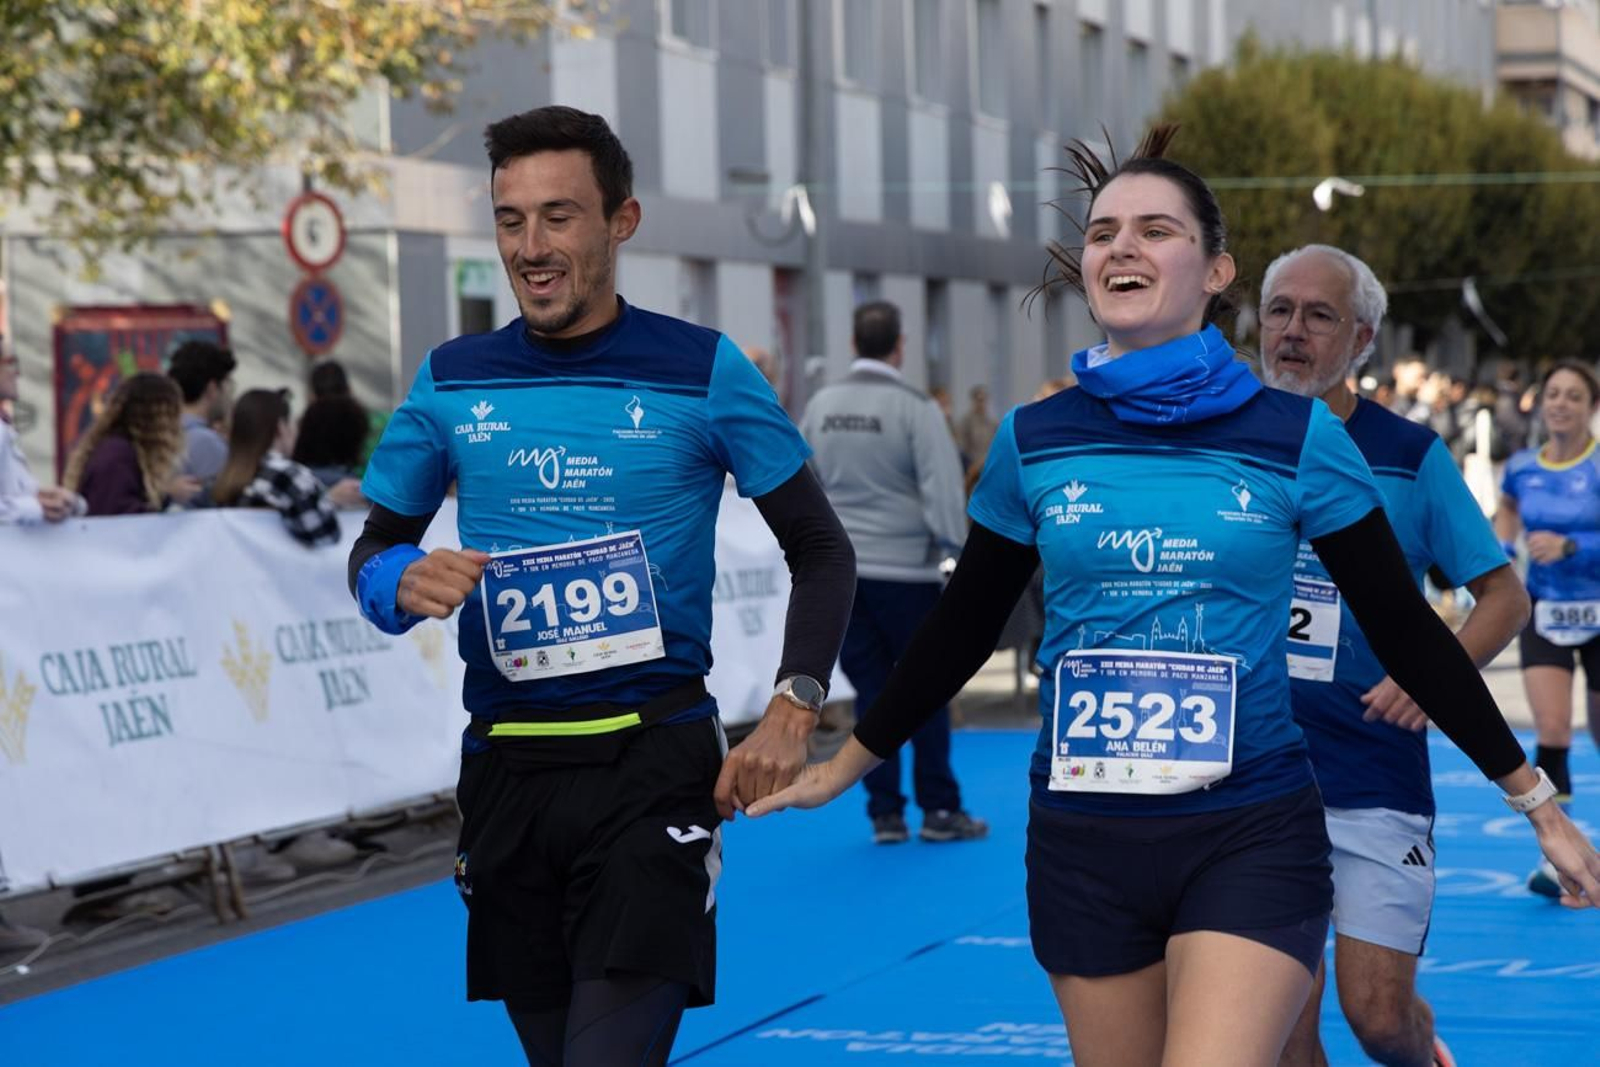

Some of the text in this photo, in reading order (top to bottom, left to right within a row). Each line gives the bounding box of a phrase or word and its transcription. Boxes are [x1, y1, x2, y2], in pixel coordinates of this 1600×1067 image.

[477, 421, 511, 432] RURAL
[468, 431, 491, 443] JAÉN
[566, 456, 598, 465] MEDIA
[564, 466, 613, 477] MARATÓN
[561, 478, 586, 489] JAÉN
[1066, 503, 1104, 514] RURAL
[1056, 513, 1081, 524] JAÉN
[1162, 538, 1198, 548] MEDIA
[536, 556, 553, 564] MEDIA
[554, 551, 582, 562] MARATÓN
[1159, 550, 1215, 561] MARATÓN
[551, 560, 575, 570] MEMORIA
[588, 555, 603, 564] PACO
[1156, 562, 1183, 573] JAÉN
[496, 571, 640, 634] 2199
[537, 626, 559, 641] JOSÉ
[563, 621, 608, 637] MANUEL
[40, 637, 198, 697] CAJA RURAL
[1115, 661, 1134, 669] MEDIA
[1135, 660, 1167, 670] MARATÓN
[1168, 662, 1195, 672] "CIUDAD
[1130, 669, 1157, 678] MEMORIA
[1172, 671, 1188, 680] PACO
[99, 688, 174, 748] JAÉN
[1066, 690, 1218, 743] 2523
[1105, 739, 1167, 754] ANA BELÉN
